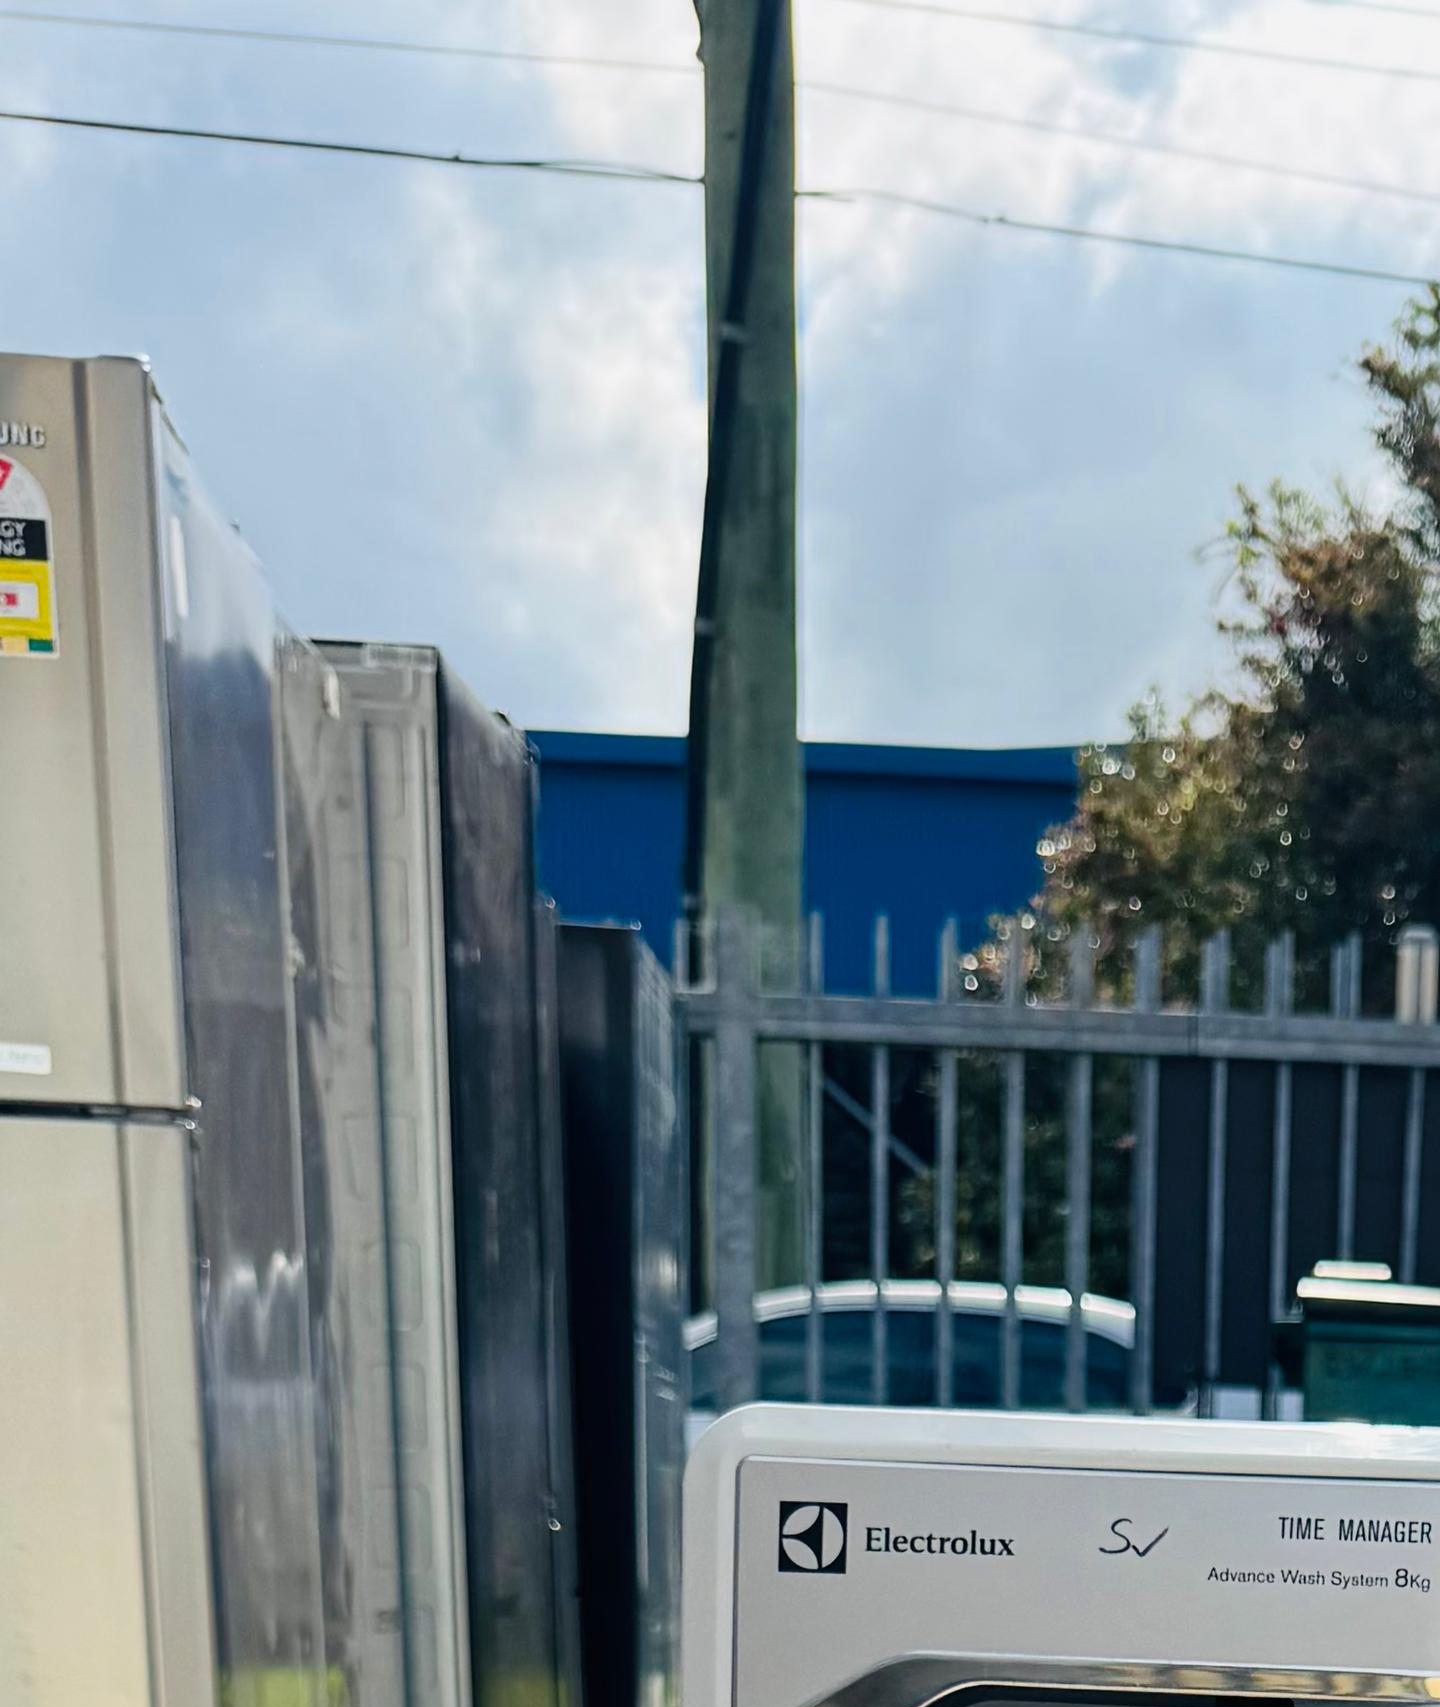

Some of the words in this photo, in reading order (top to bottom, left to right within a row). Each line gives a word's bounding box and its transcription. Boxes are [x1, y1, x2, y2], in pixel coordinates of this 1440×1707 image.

[865, 1526, 1016, 1557] Electrolux
[1278, 1516, 1325, 1541] TIME
[1338, 1518, 1433, 1544] MANAGER
[1207, 1567, 1275, 1584] Advance
[1281, 1569, 1325, 1586] Wash
[1331, 1571, 1389, 1590] System
